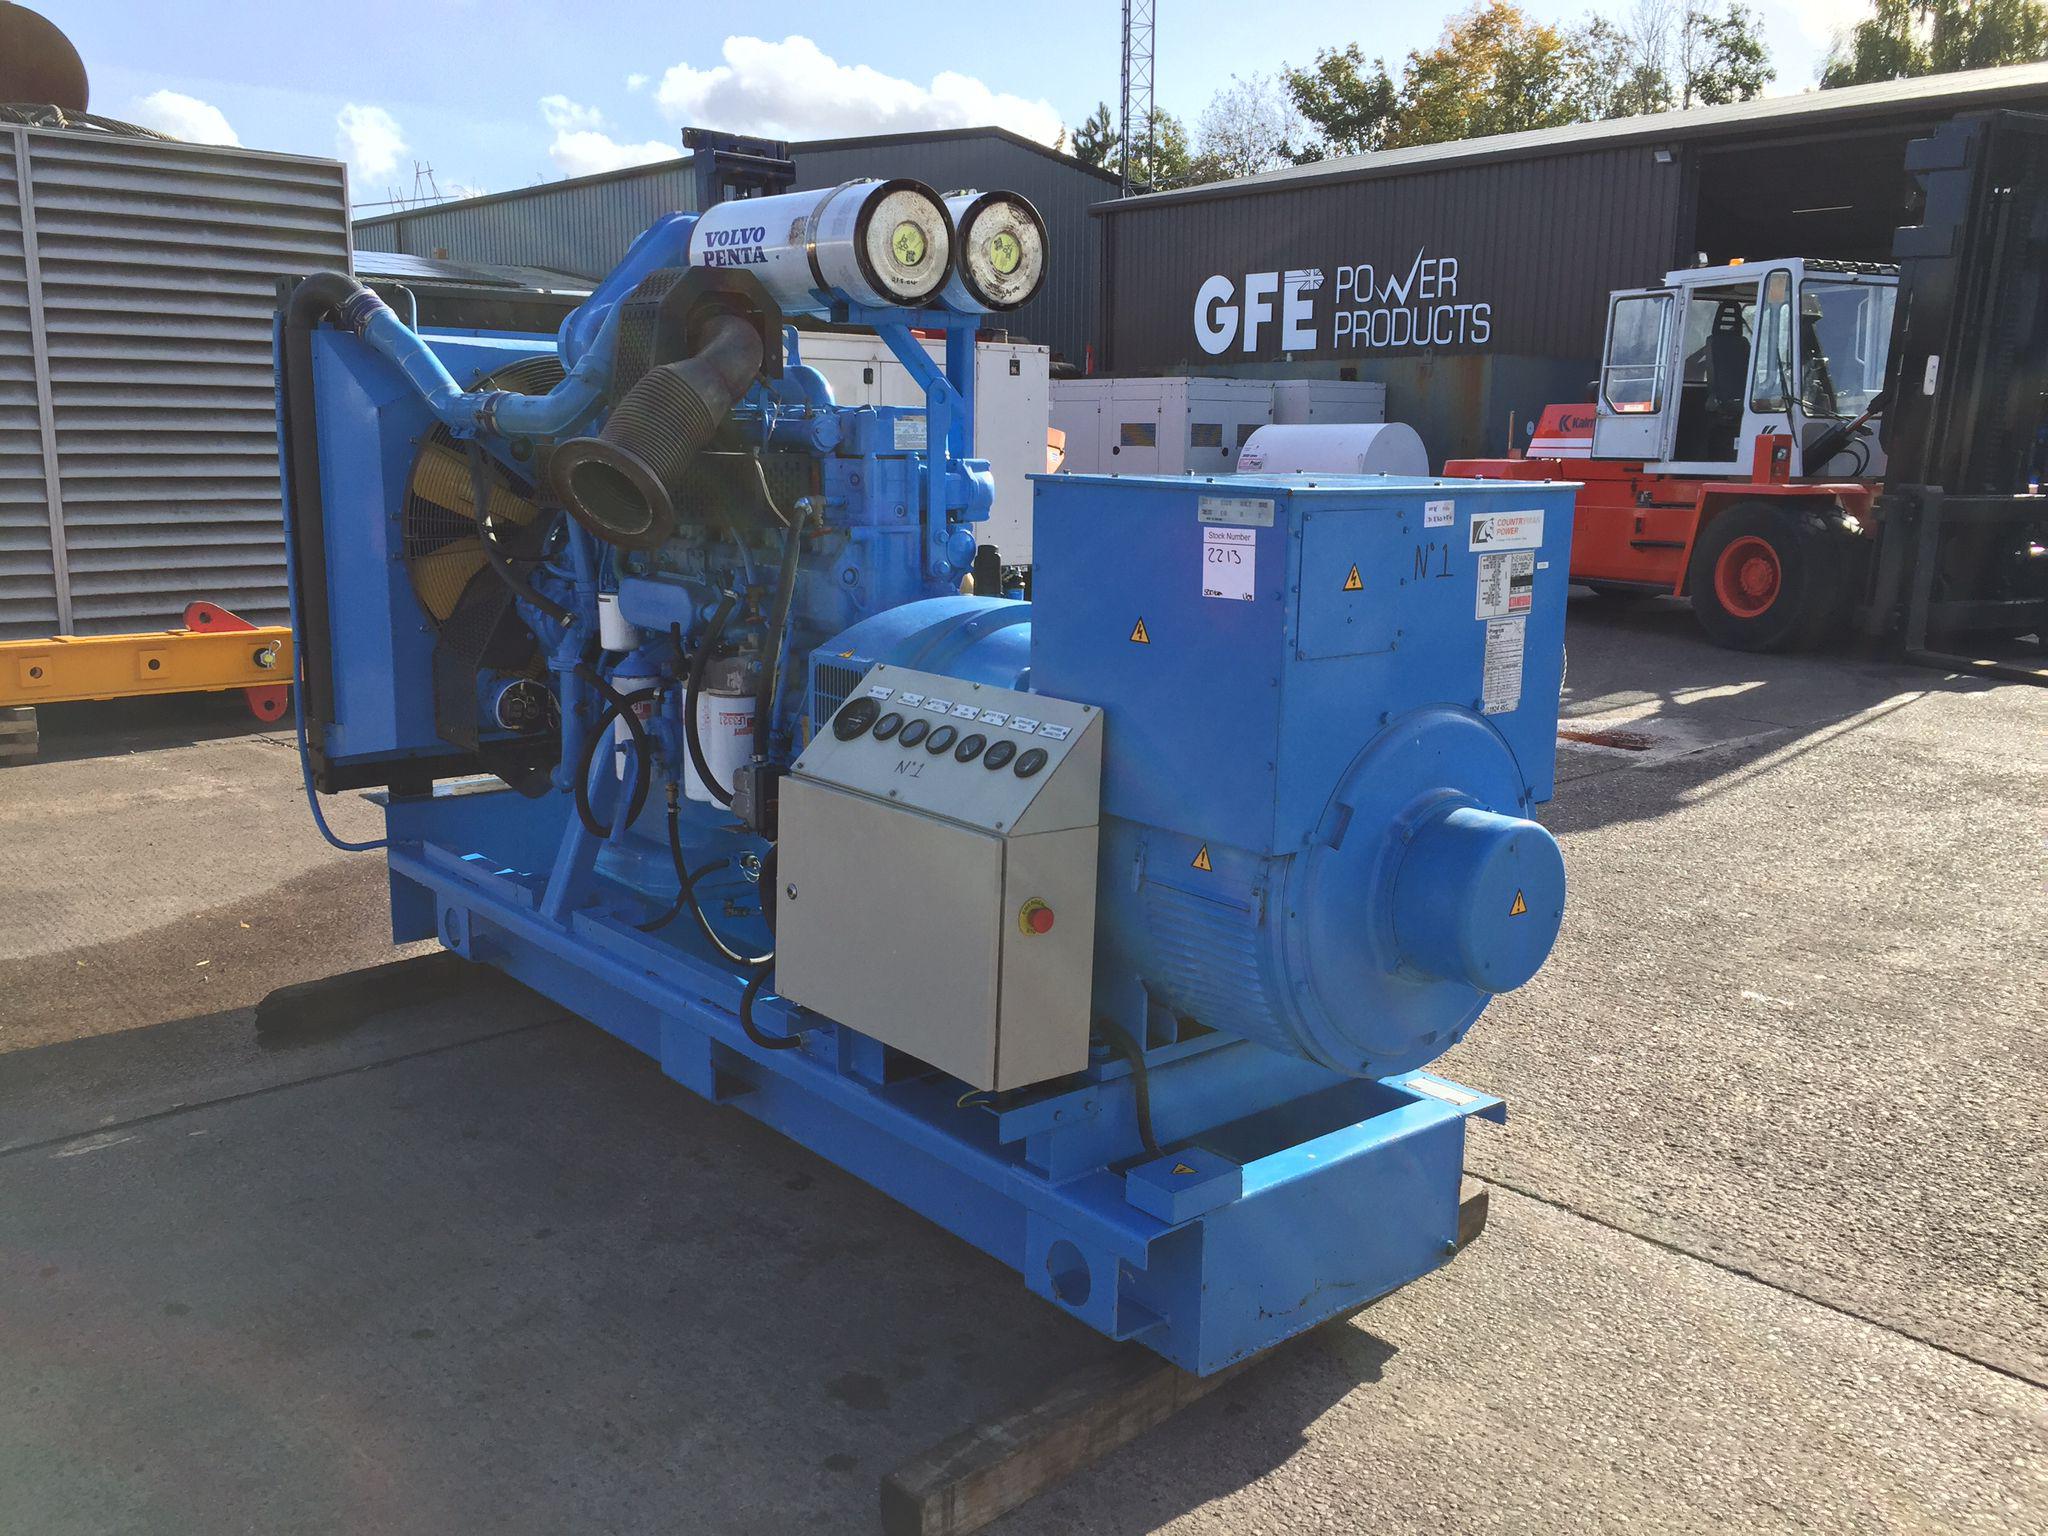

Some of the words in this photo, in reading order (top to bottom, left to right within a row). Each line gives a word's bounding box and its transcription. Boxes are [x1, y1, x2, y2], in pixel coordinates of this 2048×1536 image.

[705, 226, 766, 247] VOLVO
[703, 246, 768, 267] PENTA
[1335, 246, 1459, 305] POWER
[1193, 267, 1325, 356] GFE
[1333, 303, 1492, 349] PRODUCTS
[1208, 531, 1225, 540] Stock
[1226, 533, 1251, 541] Number
[1496, 527, 1519, 536] POWER
[1207, 547, 1242, 565] 2213
